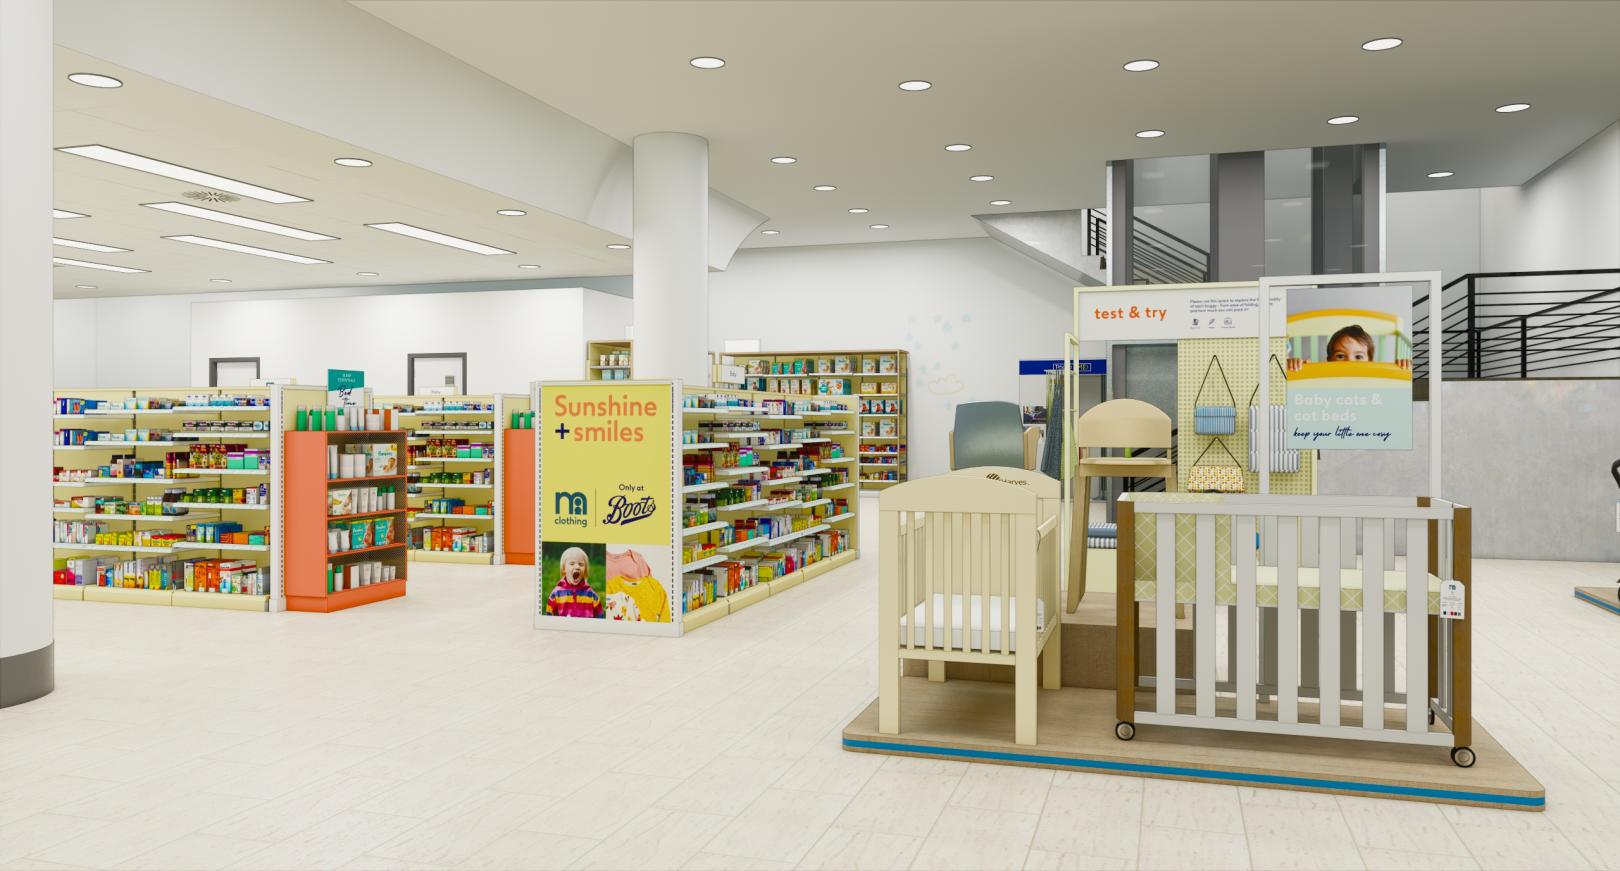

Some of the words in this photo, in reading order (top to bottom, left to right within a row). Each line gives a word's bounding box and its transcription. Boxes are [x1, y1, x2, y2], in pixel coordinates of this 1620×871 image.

[1094, 308, 1124, 320] test
[1129, 306, 1140, 319] &
[1145, 307, 1168, 322] try
[554, 394, 657, 417] Sunshine
[1294, 393, 1332, 408] Baby
[1336, 394, 1368, 406] cots
[1371, 393, 1384, 406] &
[1294, 411, 1318, 421] cot
[1321, 409, 1358, 421] beds
[574, 420, 644, 442] smiles
[1293, 427, 1311, 440] keep
[1313, 431, 1332, 441] your
[1334, 425, 1354, 439] little
[618, 484, 635, 493] Only
[602, 495, 657, 526] Boots
[554, 517, 588, 528] clothing
